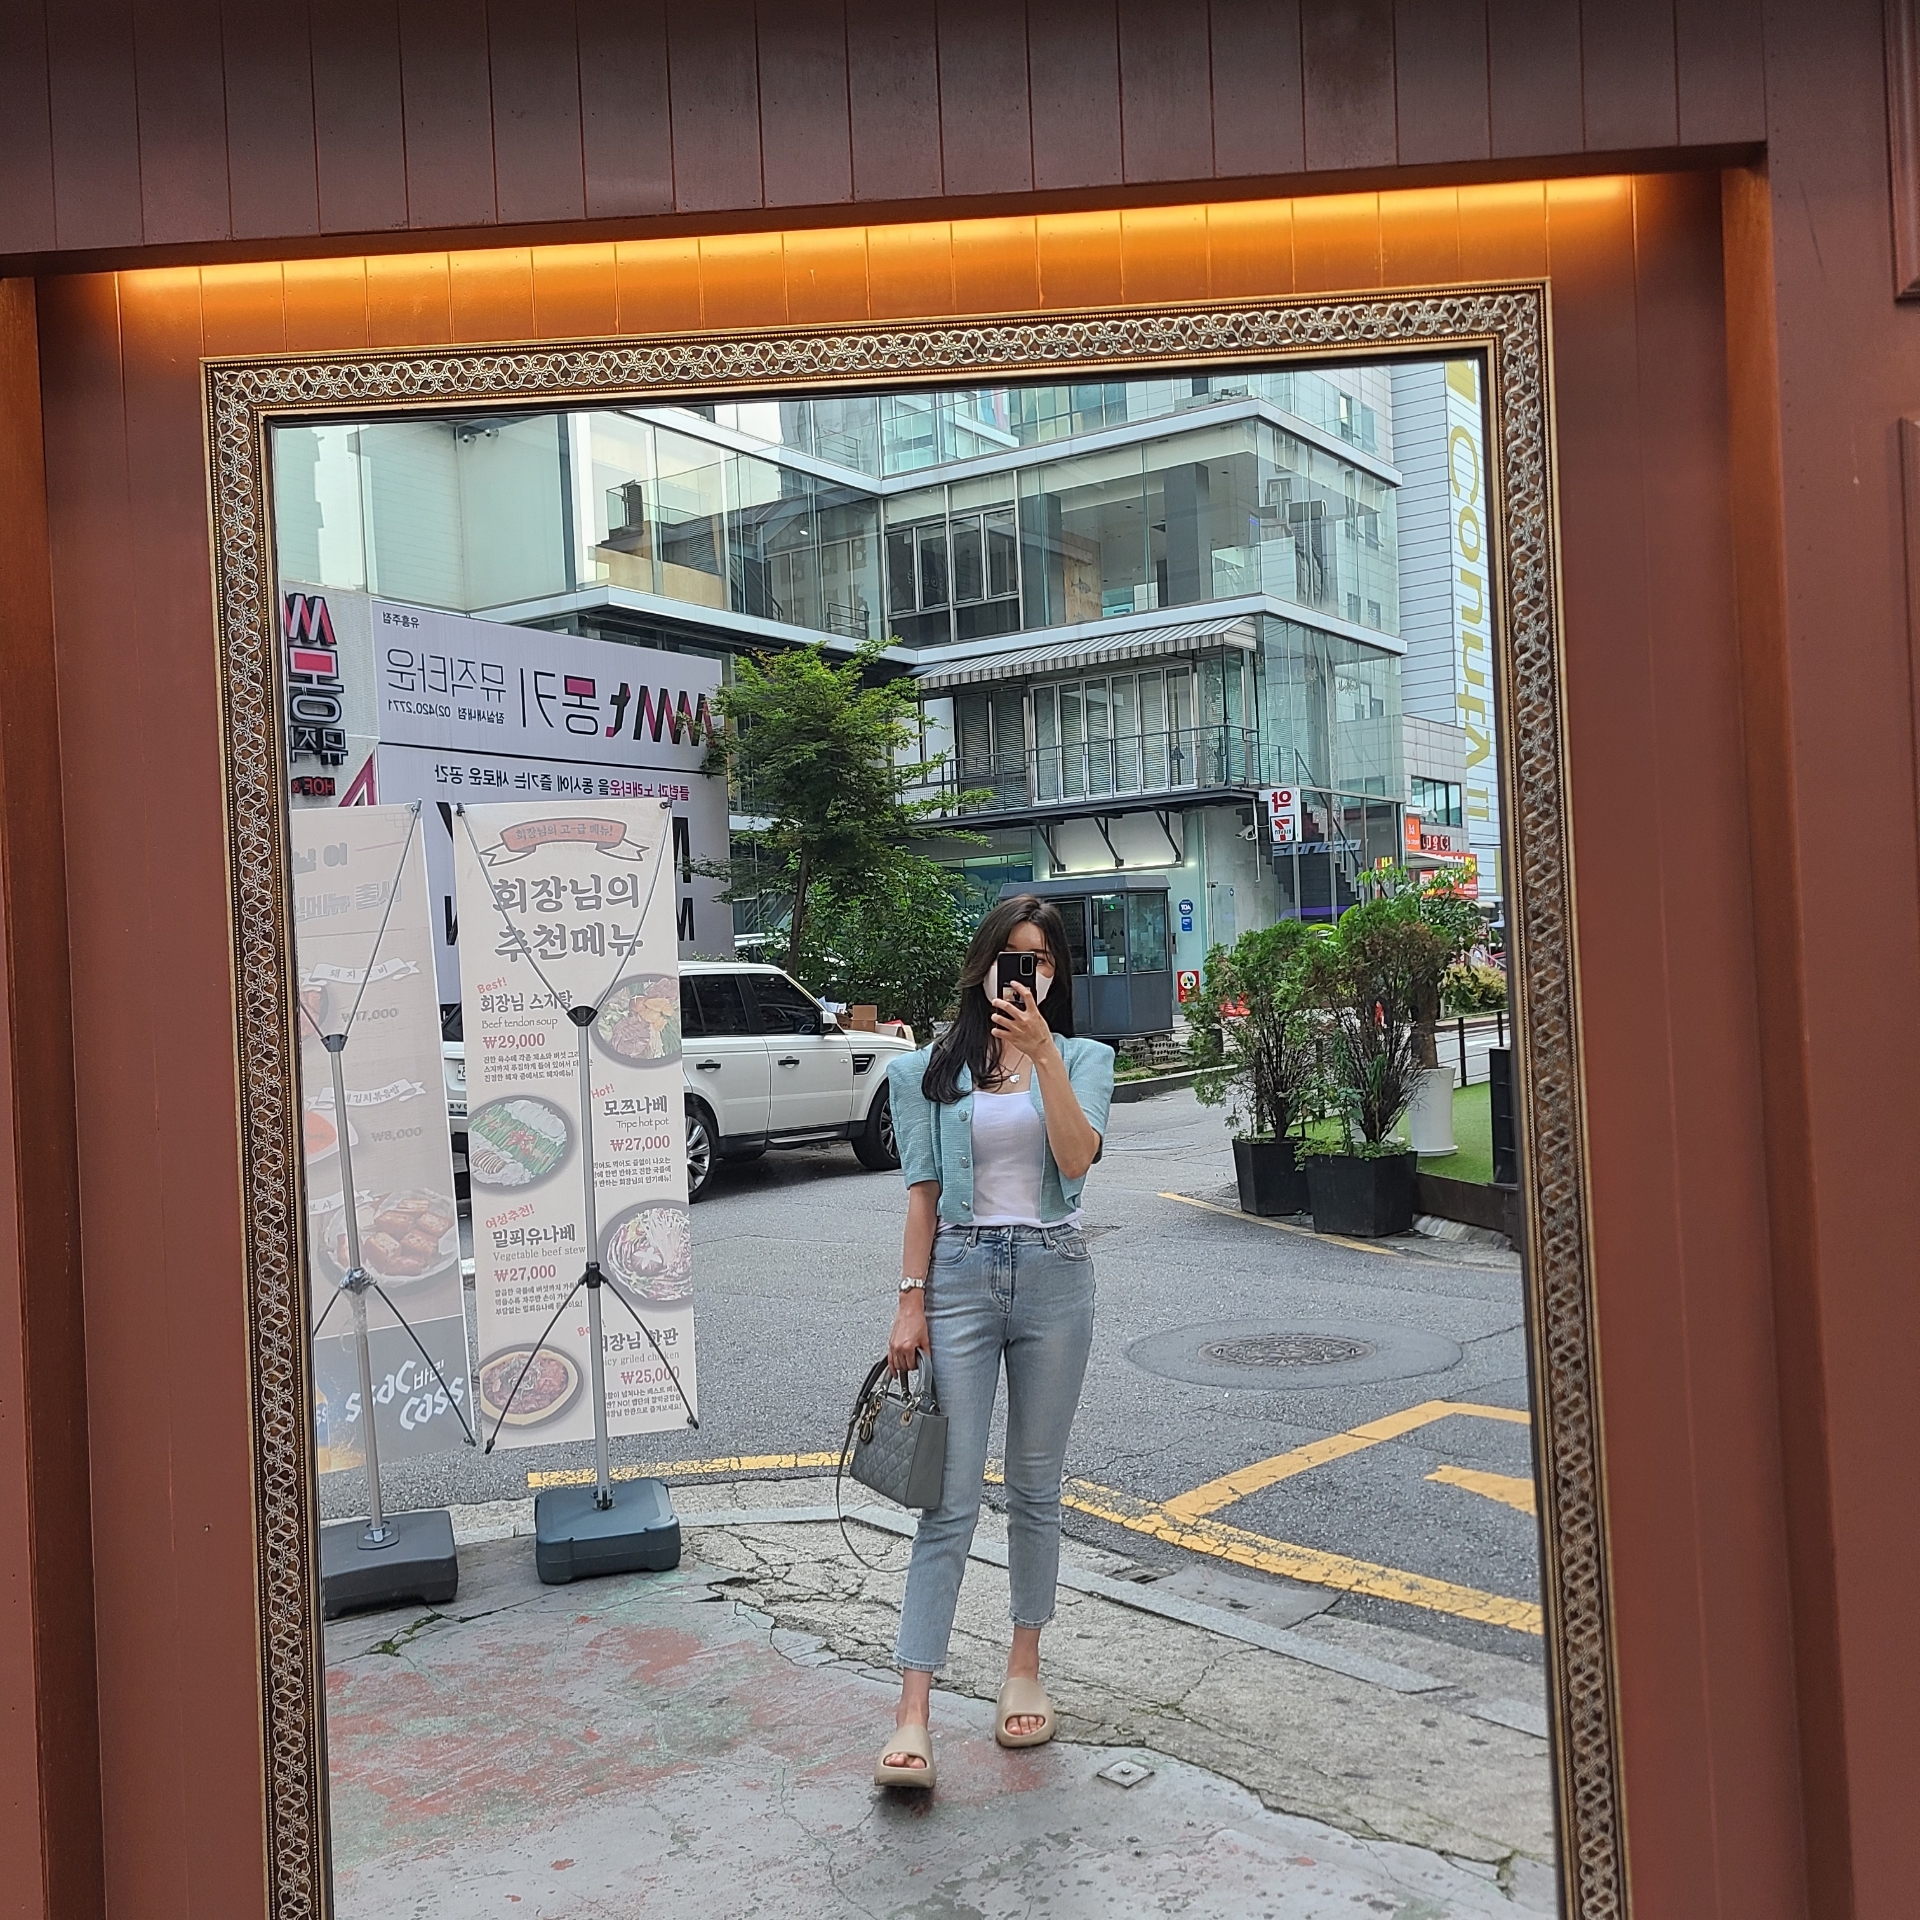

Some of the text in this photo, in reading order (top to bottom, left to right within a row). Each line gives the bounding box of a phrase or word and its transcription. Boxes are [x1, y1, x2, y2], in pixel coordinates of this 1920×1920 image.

[516, 824, 557, 840] 회장님의
[590, 824, 613, 836] 메뉴!
[492, 872, 640, 914] 회장님의
[494, 922, 643, 963] 추천메뉴
[477, 976, 508, 994] Best!
[480, 990, 573, 1014] 회장님 스지탕
[481, 1018, 558, 1030] Beef tendon soup
[591, 1084, 616, 1099] Hot!
[603, 1095, 668, 1117] 모쯔나베
[616, 1117, 670, 1133] Tripe hot pot
[486, 1204, 536, 1229] 여성추천!
[492, 1223, 576, 1249] 밀푀유나베
[492, 1246, 586, 1262] Vegetable beef stew
[648, 1327, 679, 1348] 한판
